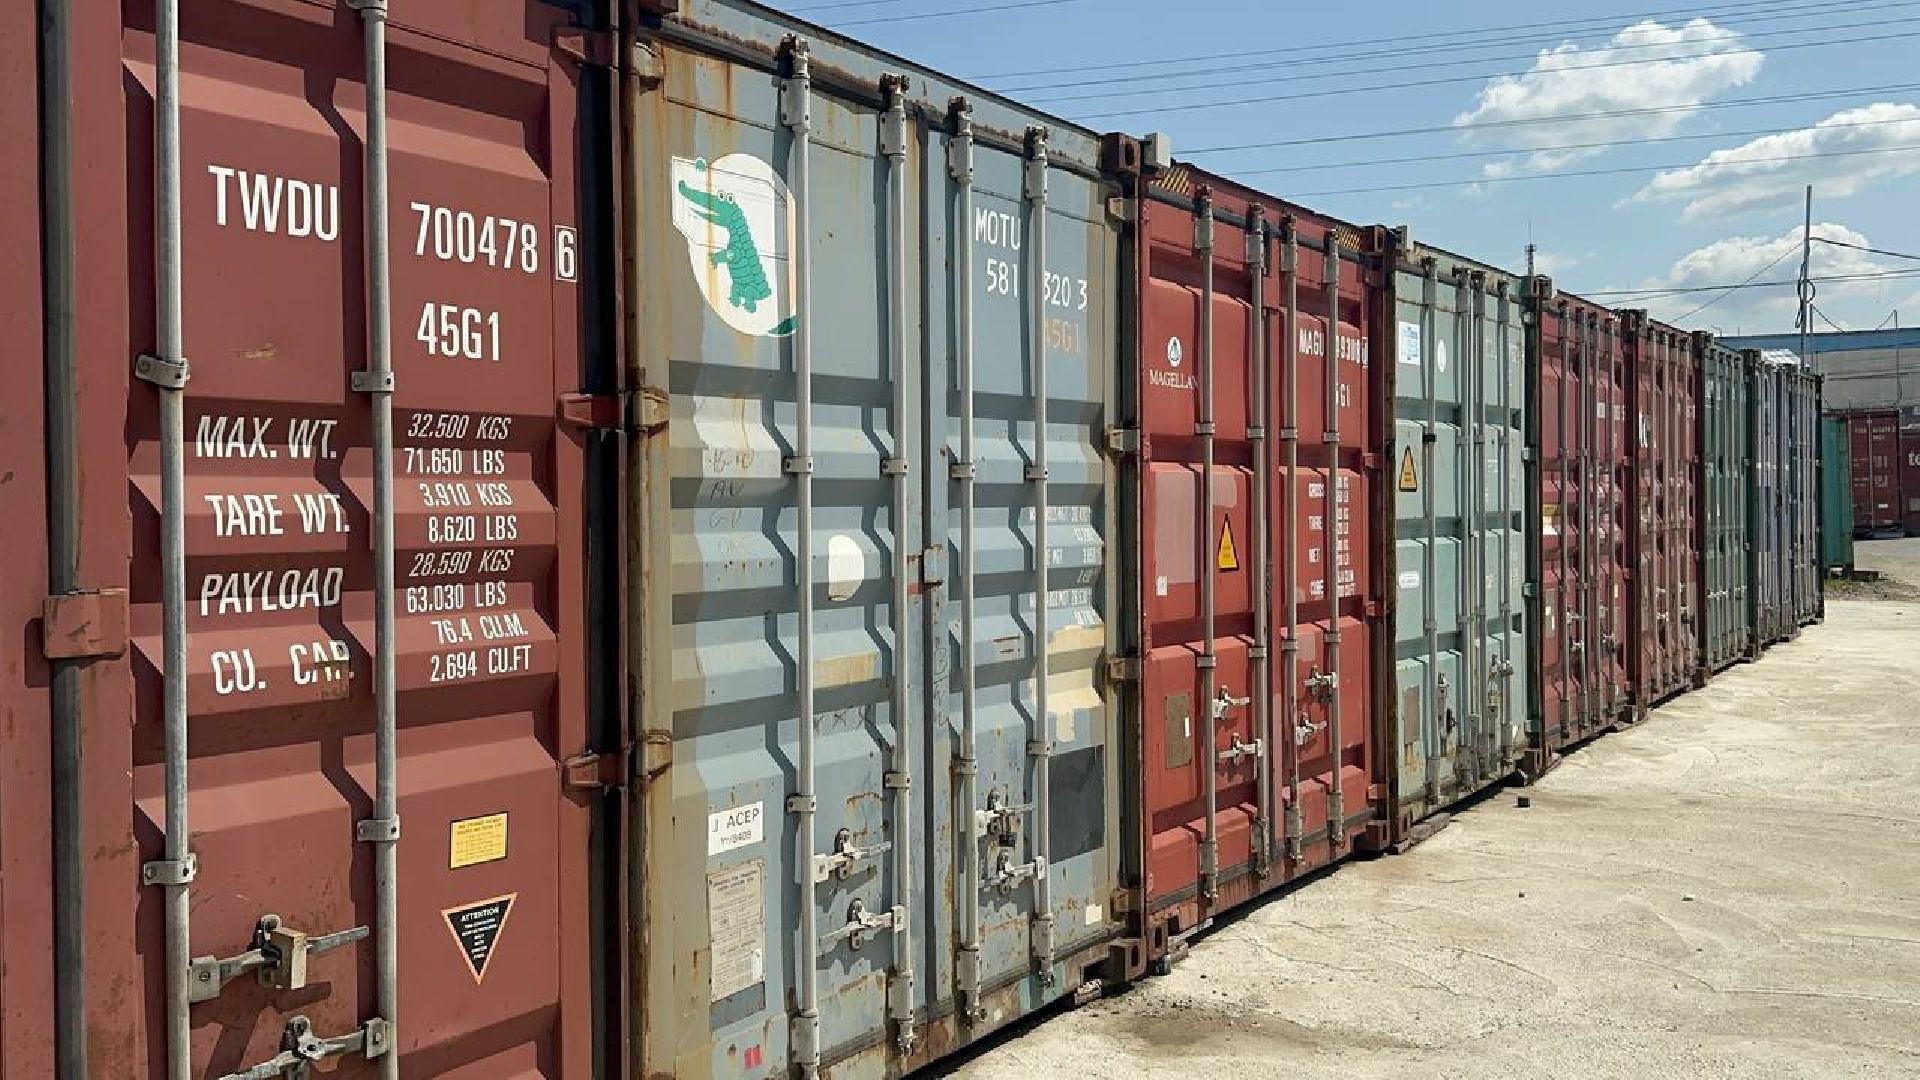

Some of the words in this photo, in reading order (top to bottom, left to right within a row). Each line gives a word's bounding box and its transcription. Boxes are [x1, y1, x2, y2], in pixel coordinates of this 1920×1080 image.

[207, 165, 338, 241] TWDU
[410, 201, 539, 274] 700478
[555, 225, 578, 282] 6
[975, 206, 1021, 250] MOTU
[987, 258, 1018, 298] 581
[1077, 279, 1088, 310] 3
[417, 302, 501, 361] 45G1
[195, 415, 278, 459] MAX.
[287, 417, 338, 460] WT.
[475, 415, 512, 440] KGS
[473, 449, 505, 475] LBS
[204, 494, 284, 537] TARE
[294, 493, 351, 534] WT.
[476, 483, 513, 507] KGS
[485, 515, 518, 541] LBS
[201, 566, 344, 617] PAYLOAD
[478, 548, 515, 575] KGS
[474, 581, 507, 607] LBS
[430, 618, 472, 645] 76.4
[210, 647, 266, 695] CU.
[487, 644, 532, 675] CU.FT
[726, 807, 760, 829] ACEP
[461, 906, 500, 922] ATTENTION
